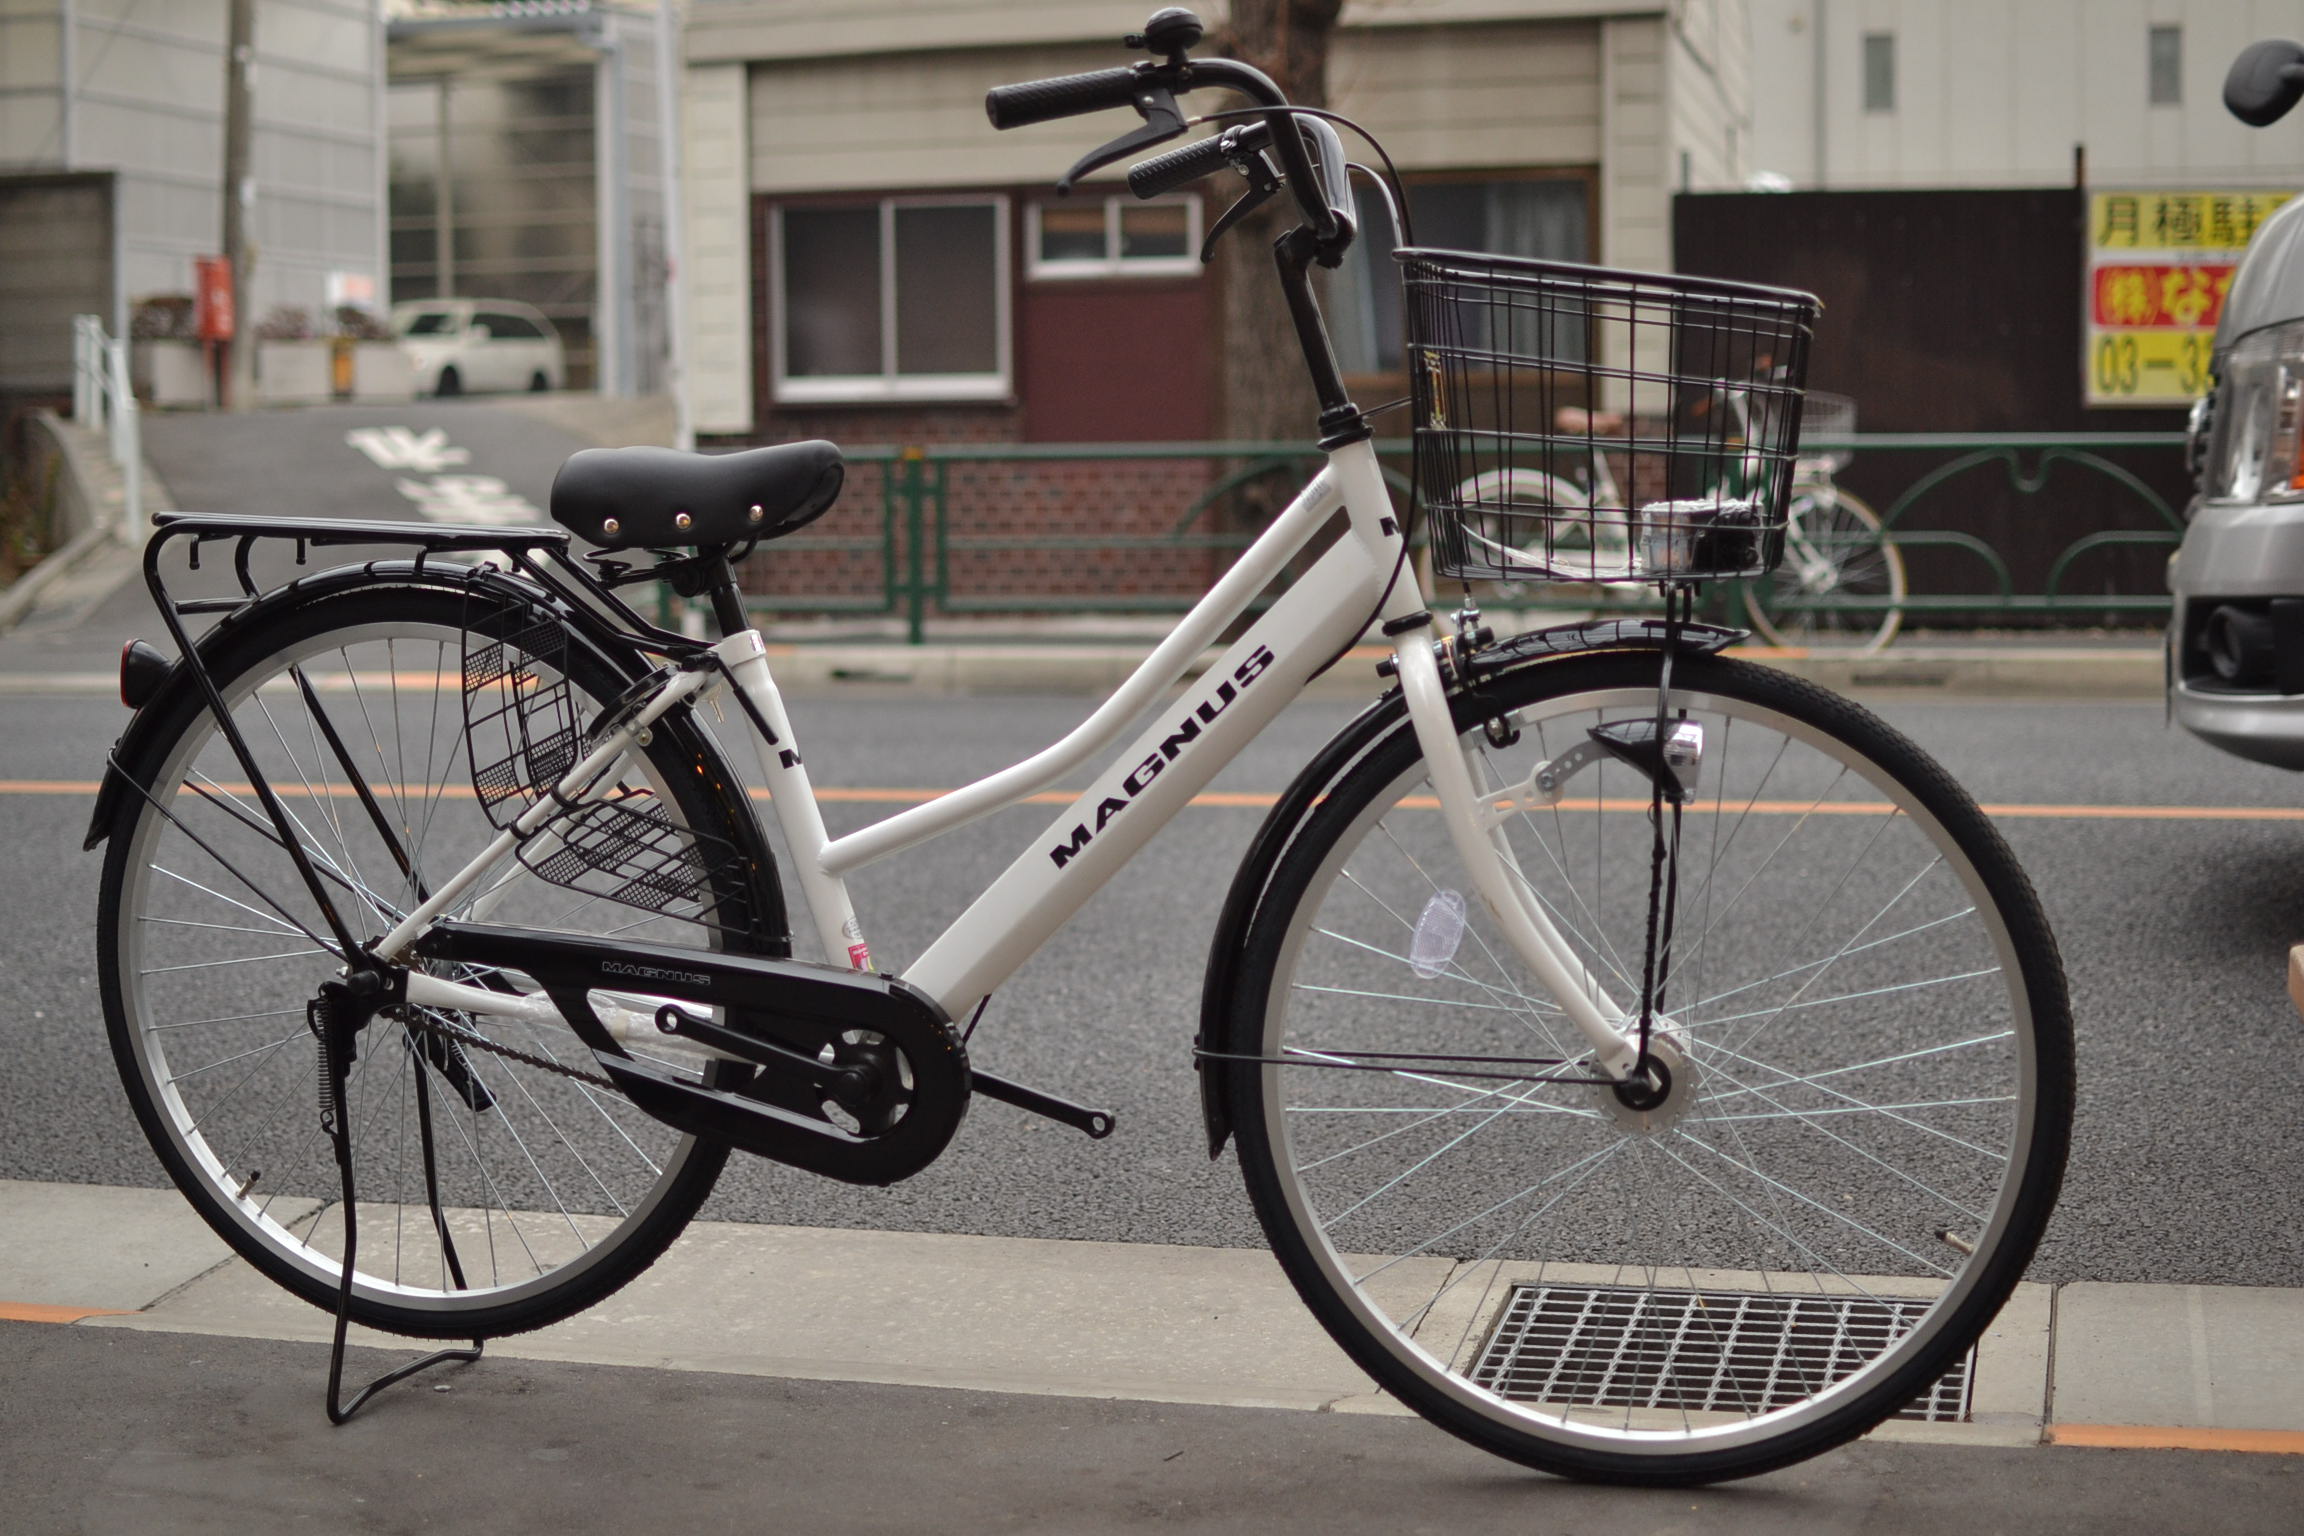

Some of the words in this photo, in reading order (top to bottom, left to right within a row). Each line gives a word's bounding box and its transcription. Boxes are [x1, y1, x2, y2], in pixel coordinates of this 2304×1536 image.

[2098, 194, 2290, 247] 月極駐
[1050, 644, 1275, 869] MAGNUS
[602, 961, 711, 985] MAGNUS
